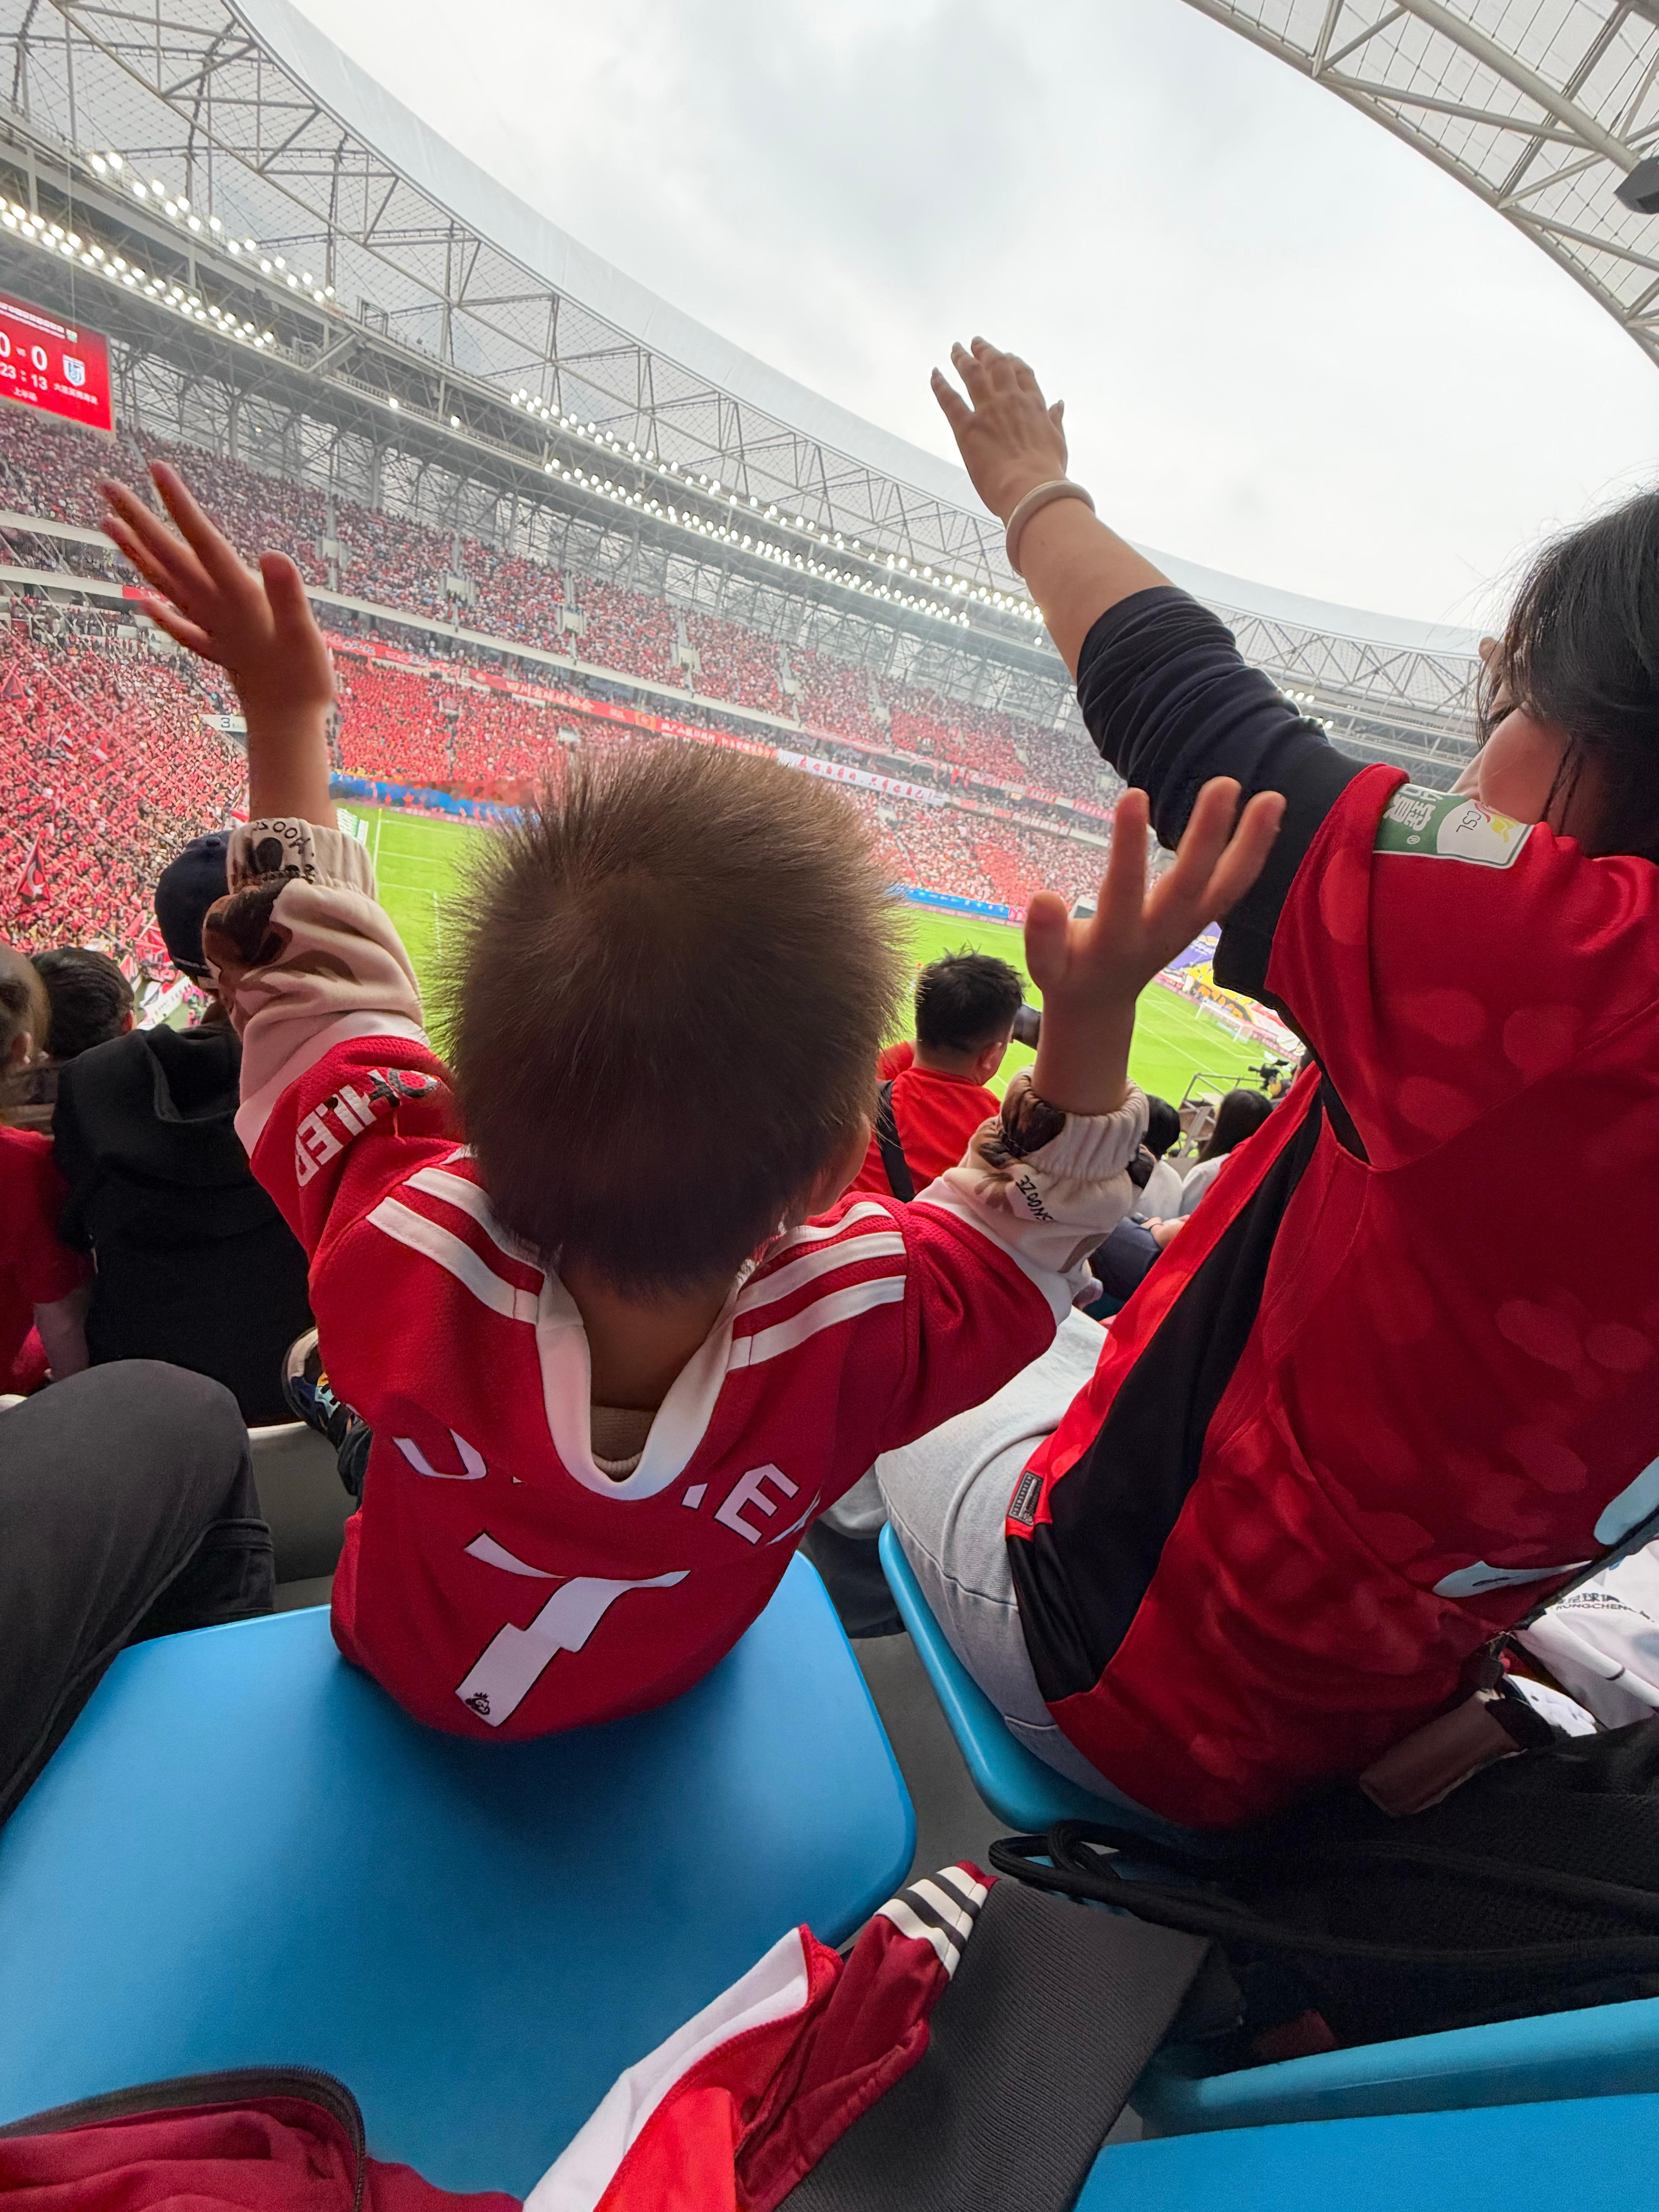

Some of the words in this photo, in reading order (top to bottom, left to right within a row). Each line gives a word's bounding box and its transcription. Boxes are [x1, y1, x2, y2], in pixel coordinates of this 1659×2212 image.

[221, 717, 230, 728] 3
[1456, 811, 1481, 833] CSL
[295, 1068, 440, 1187] OHLER
[1015, 1174, 1056, 1223] SNOOZE
[455, 1532, 691, 1728] 7
